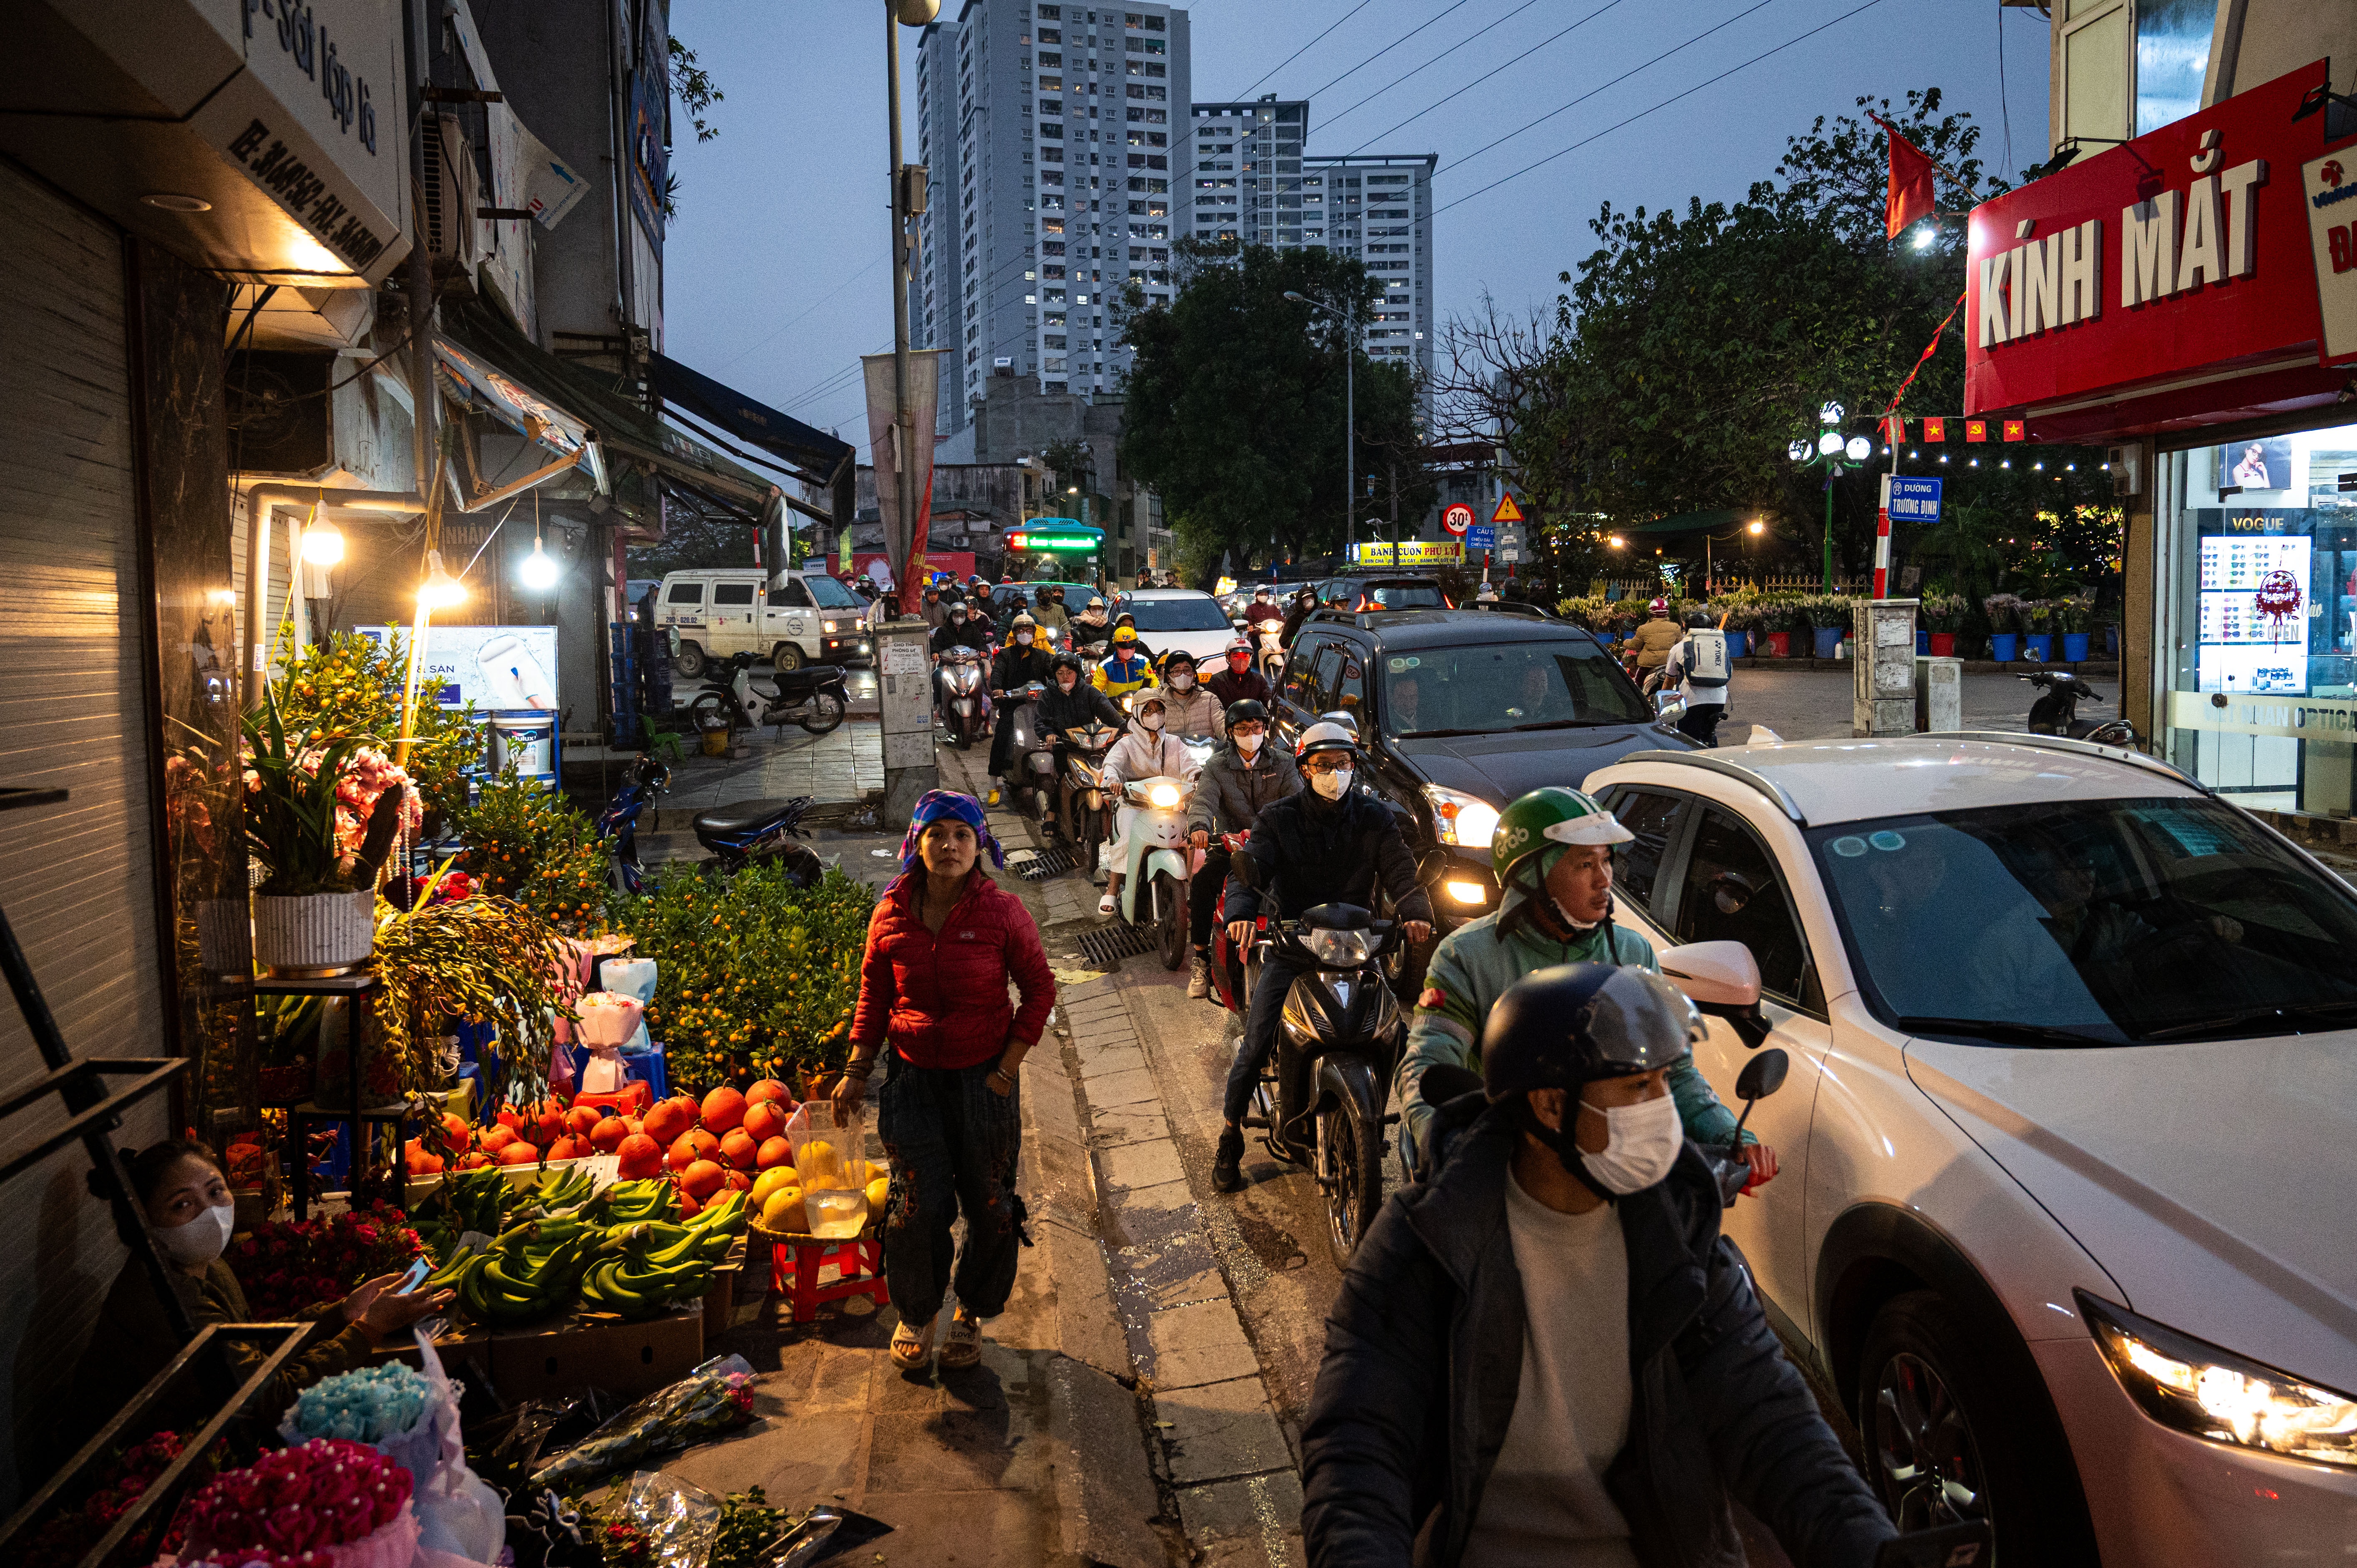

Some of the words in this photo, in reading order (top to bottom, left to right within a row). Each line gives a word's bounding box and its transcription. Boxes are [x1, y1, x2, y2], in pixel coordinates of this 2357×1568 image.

[1979, 219, 2101, 349] KÍNH
[2122, 129, 2266, 309] MẮT
[1904, 482, 1932, 493] ĐƯỜNG
[1893, 498, 1919, 514] TRƯƠNG
[1920, 500, 1937, 518] ĐỊNH
[2232, 517, 2284, 531] VOGUE
[1425, 544, 1443, 555] PHỦ
[430, 664, 454, 673] SÀN
[1495, 827, 1529, 859] Grab
